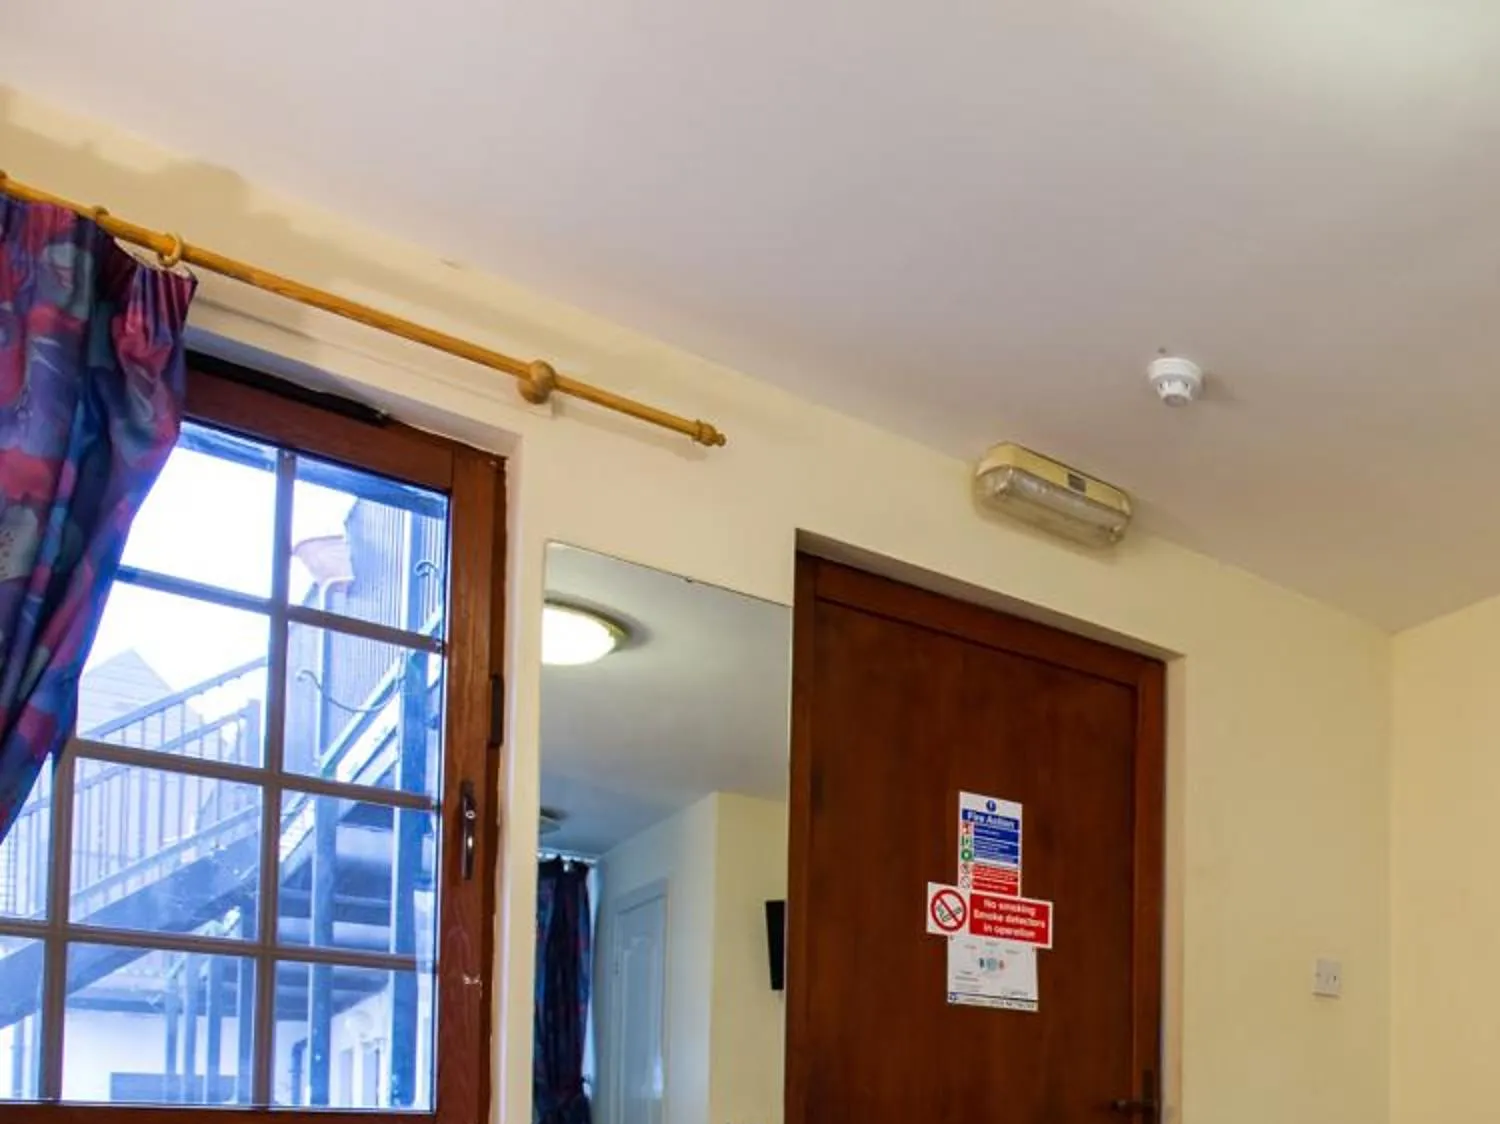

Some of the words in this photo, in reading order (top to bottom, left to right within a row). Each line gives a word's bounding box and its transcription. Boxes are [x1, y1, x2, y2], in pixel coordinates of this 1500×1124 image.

[983, 899, 997, 909] No
[999, 902, 1036, 917] smoking
[973, 909, 1003, 922] Smoke
[1005, 913, 1046, 928] detectors
[994, 924, 1036, 938] operation
